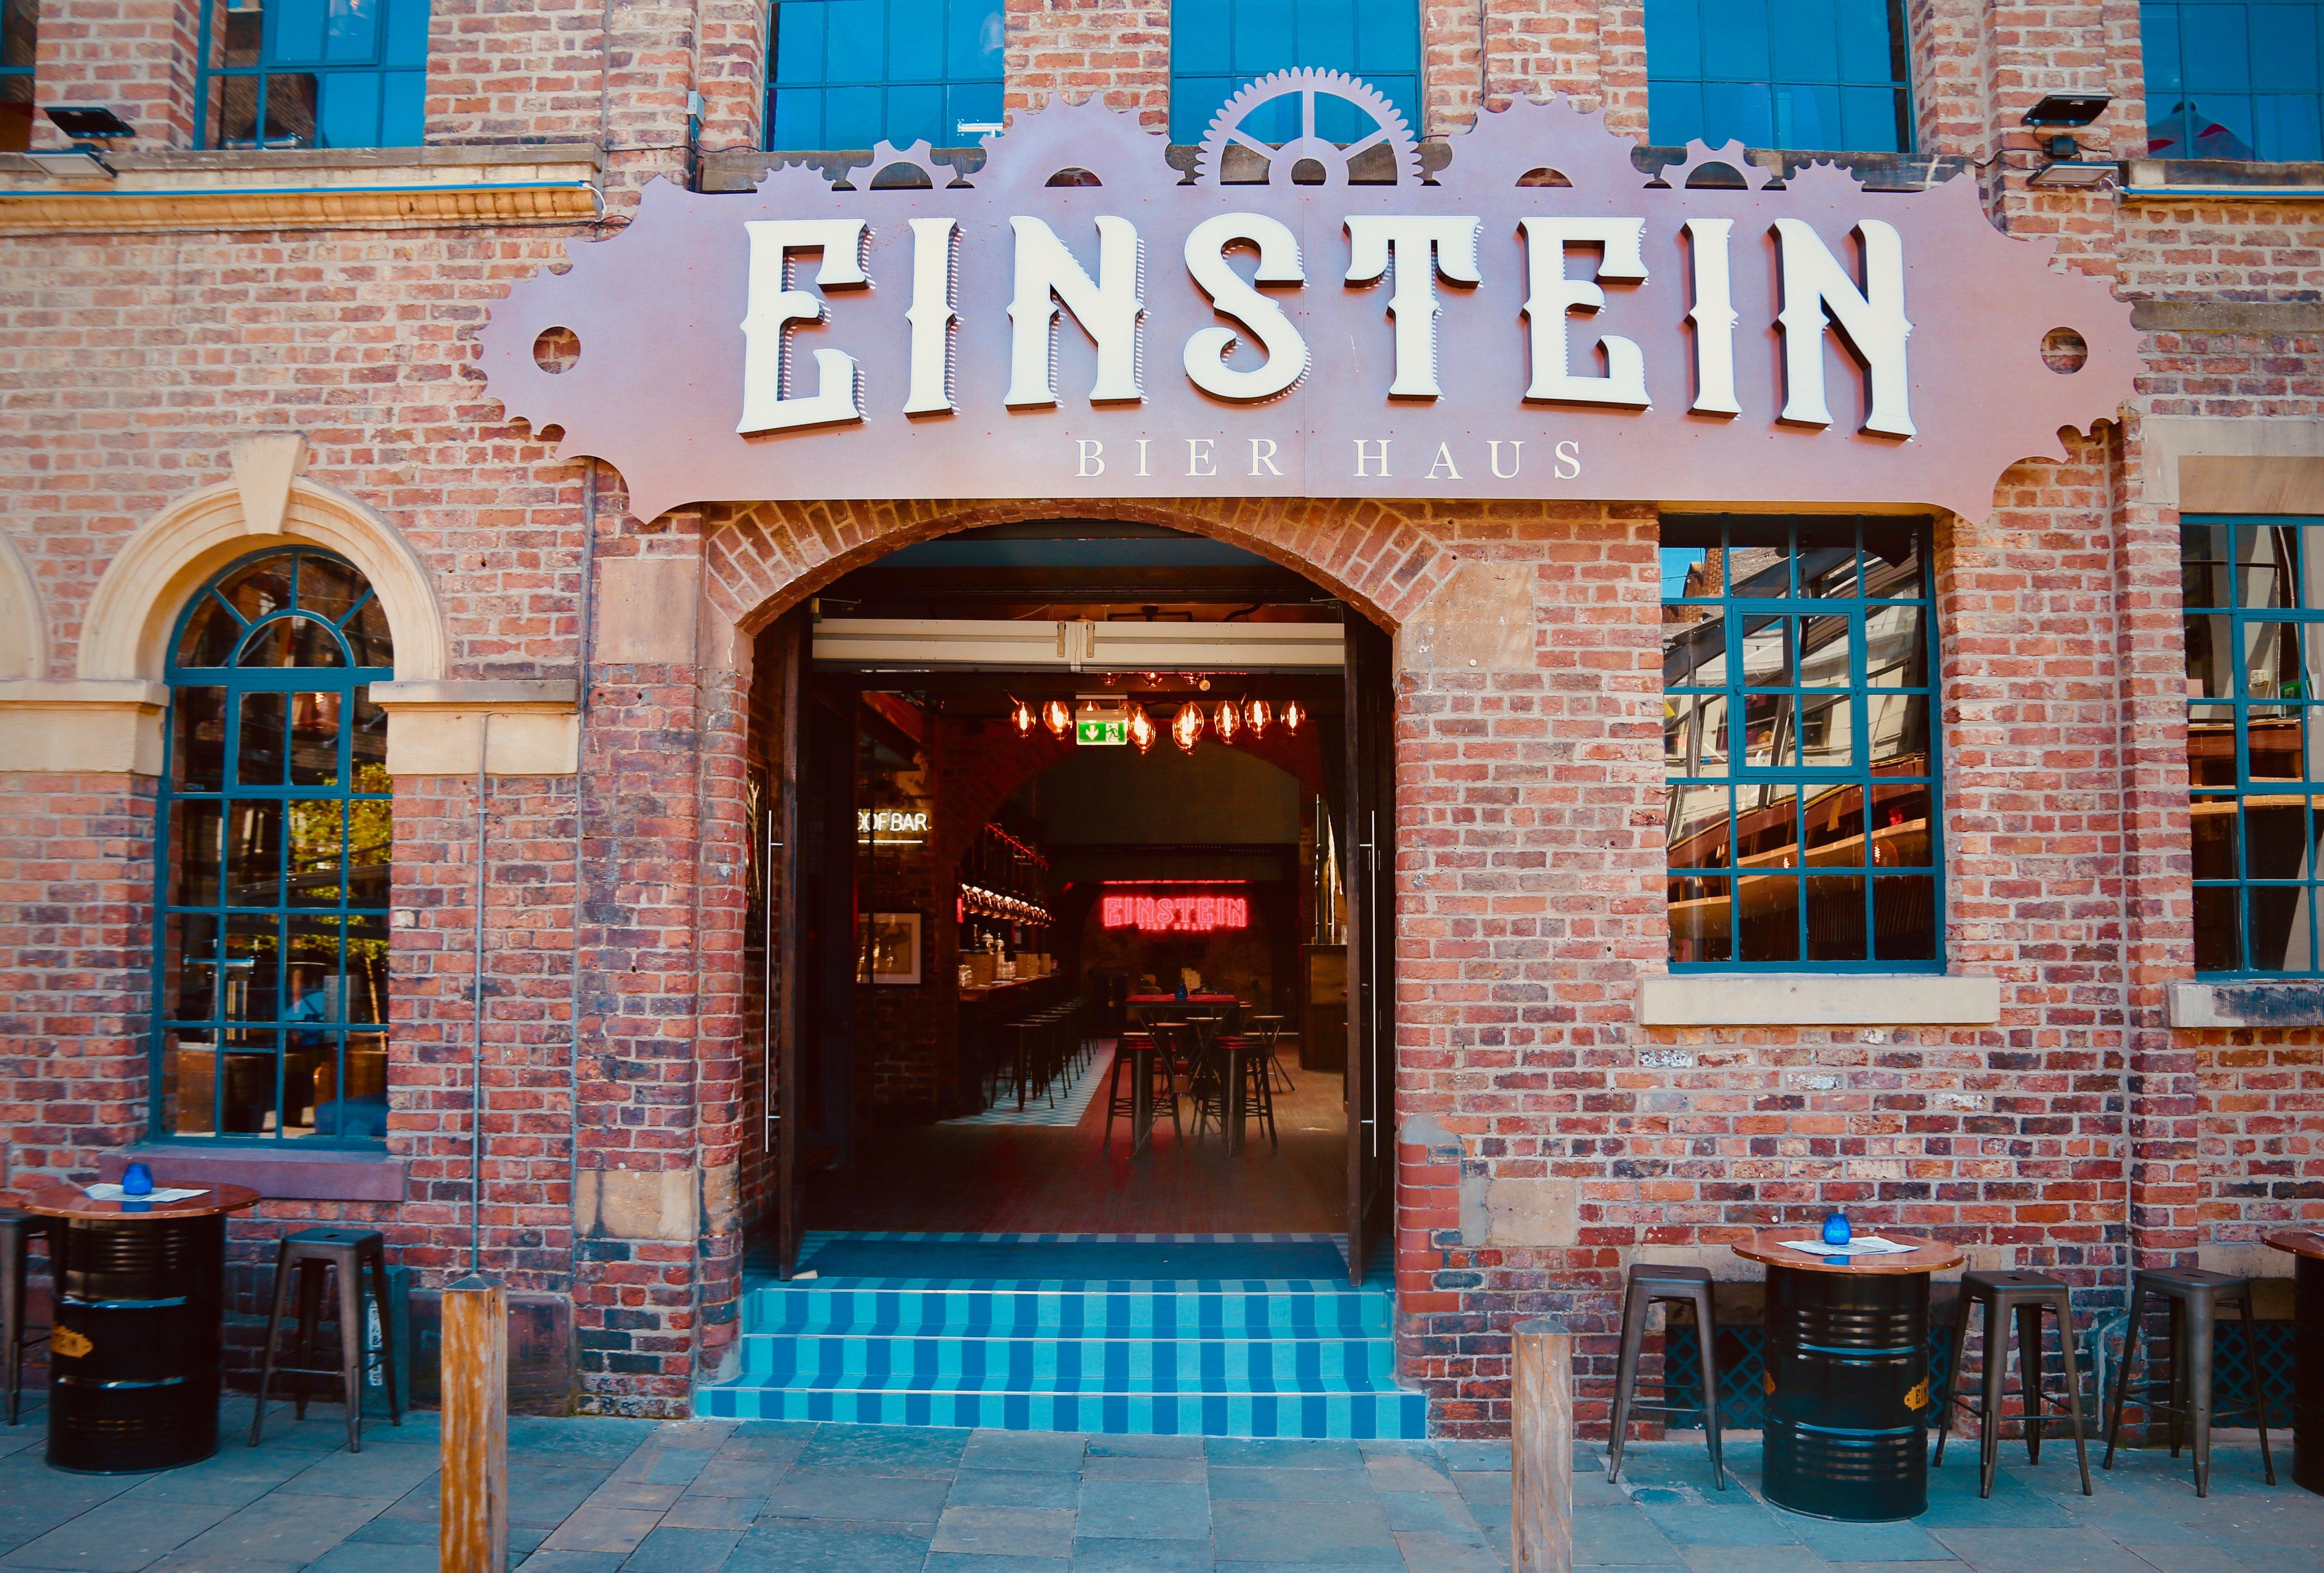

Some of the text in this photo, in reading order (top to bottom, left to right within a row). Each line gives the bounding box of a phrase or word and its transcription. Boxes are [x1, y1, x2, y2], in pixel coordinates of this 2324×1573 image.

[735, 212, 1918, 442] EINSTEIN
[1074, 439, 1581, 479] BIER HAUS
[889, 812, 928, 831] BAR
[1104, 896, 1247, 928] EINSTEIN
